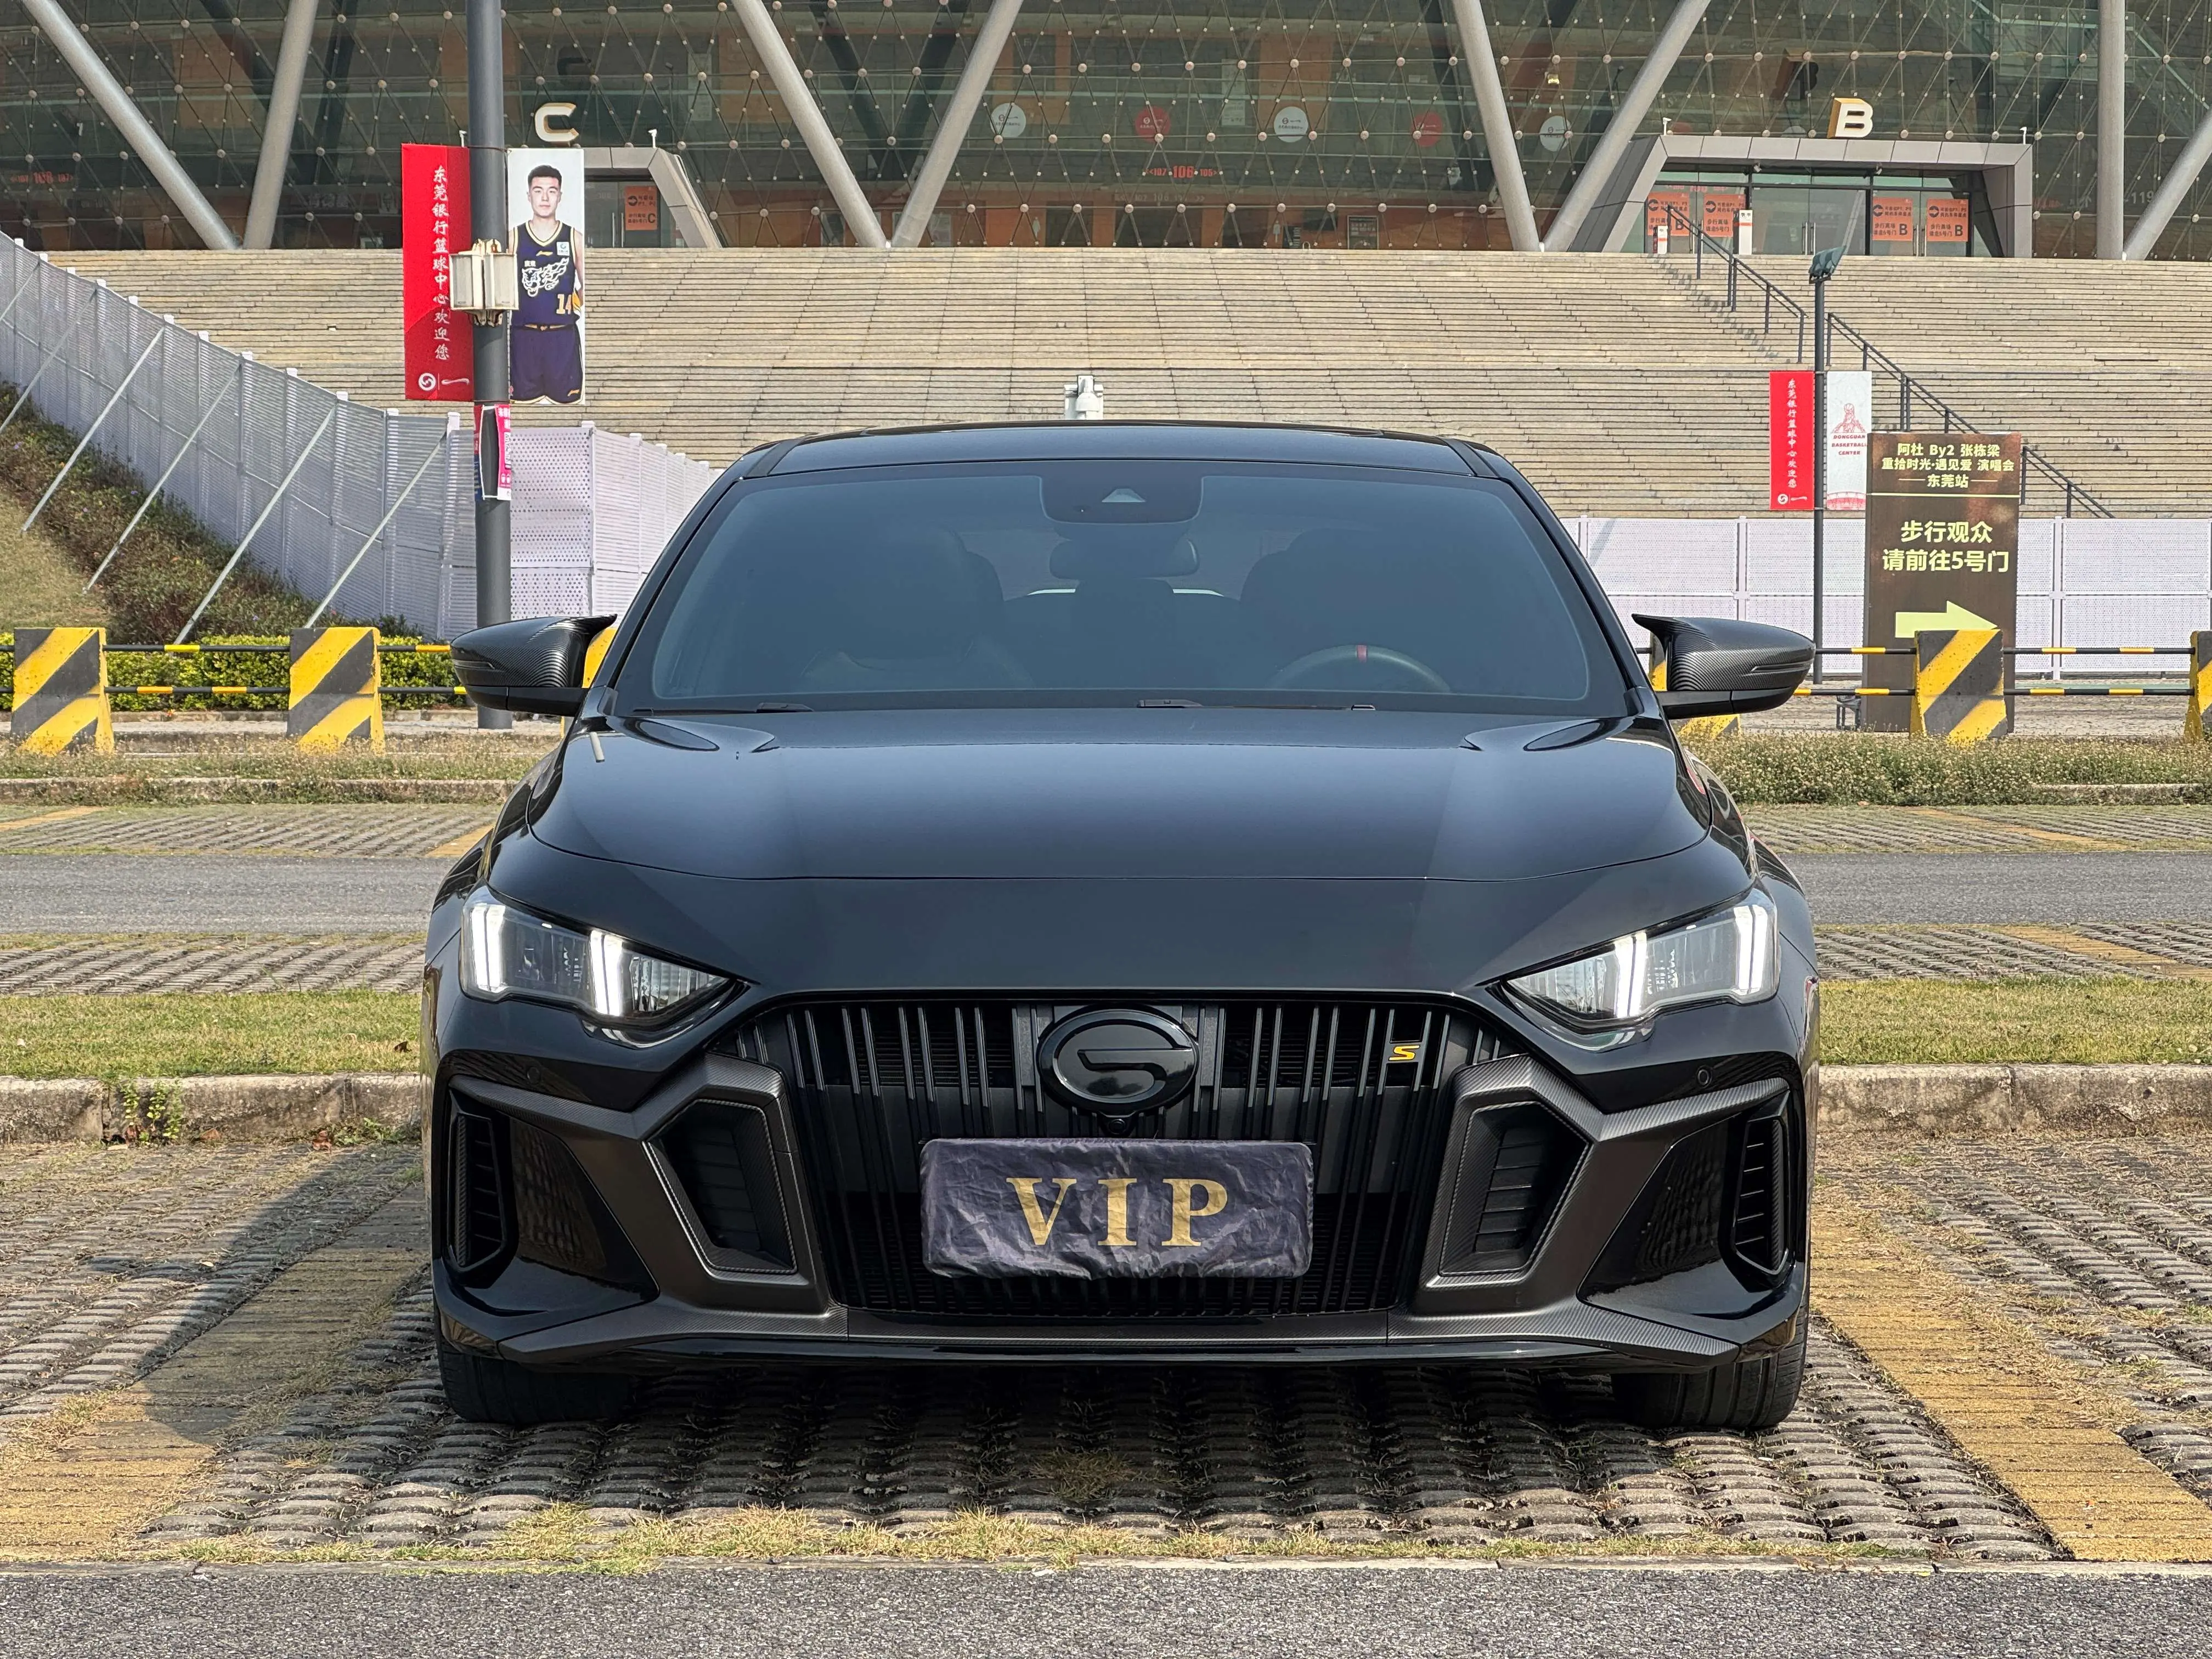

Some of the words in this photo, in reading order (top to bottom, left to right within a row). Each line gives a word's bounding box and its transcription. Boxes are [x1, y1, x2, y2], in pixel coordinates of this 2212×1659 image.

[534, 103, 579, 142] C
[1828, 97, 1874, 138] B
[1899, 223, 1908, 235] B
[1955, 224, 1963, 236] B
[432, 165, 450, 360] 东莞银行篮球中心欢迎您
[1897, 443, 1923, 456] 阿杜
[1929, 444, 1954, 458] By2
[1960, 443, 2000, 457] 张栋梁
[1977, 459, 2015, 472] 演唱会
[1927, 474, 1969, 488] 东莞站
[1900, 520, 1993, 544] 步行观众
[1882, 549, 2009, 573] 请前往5号门
[1006, 1177, 1228, 1247] VIP
